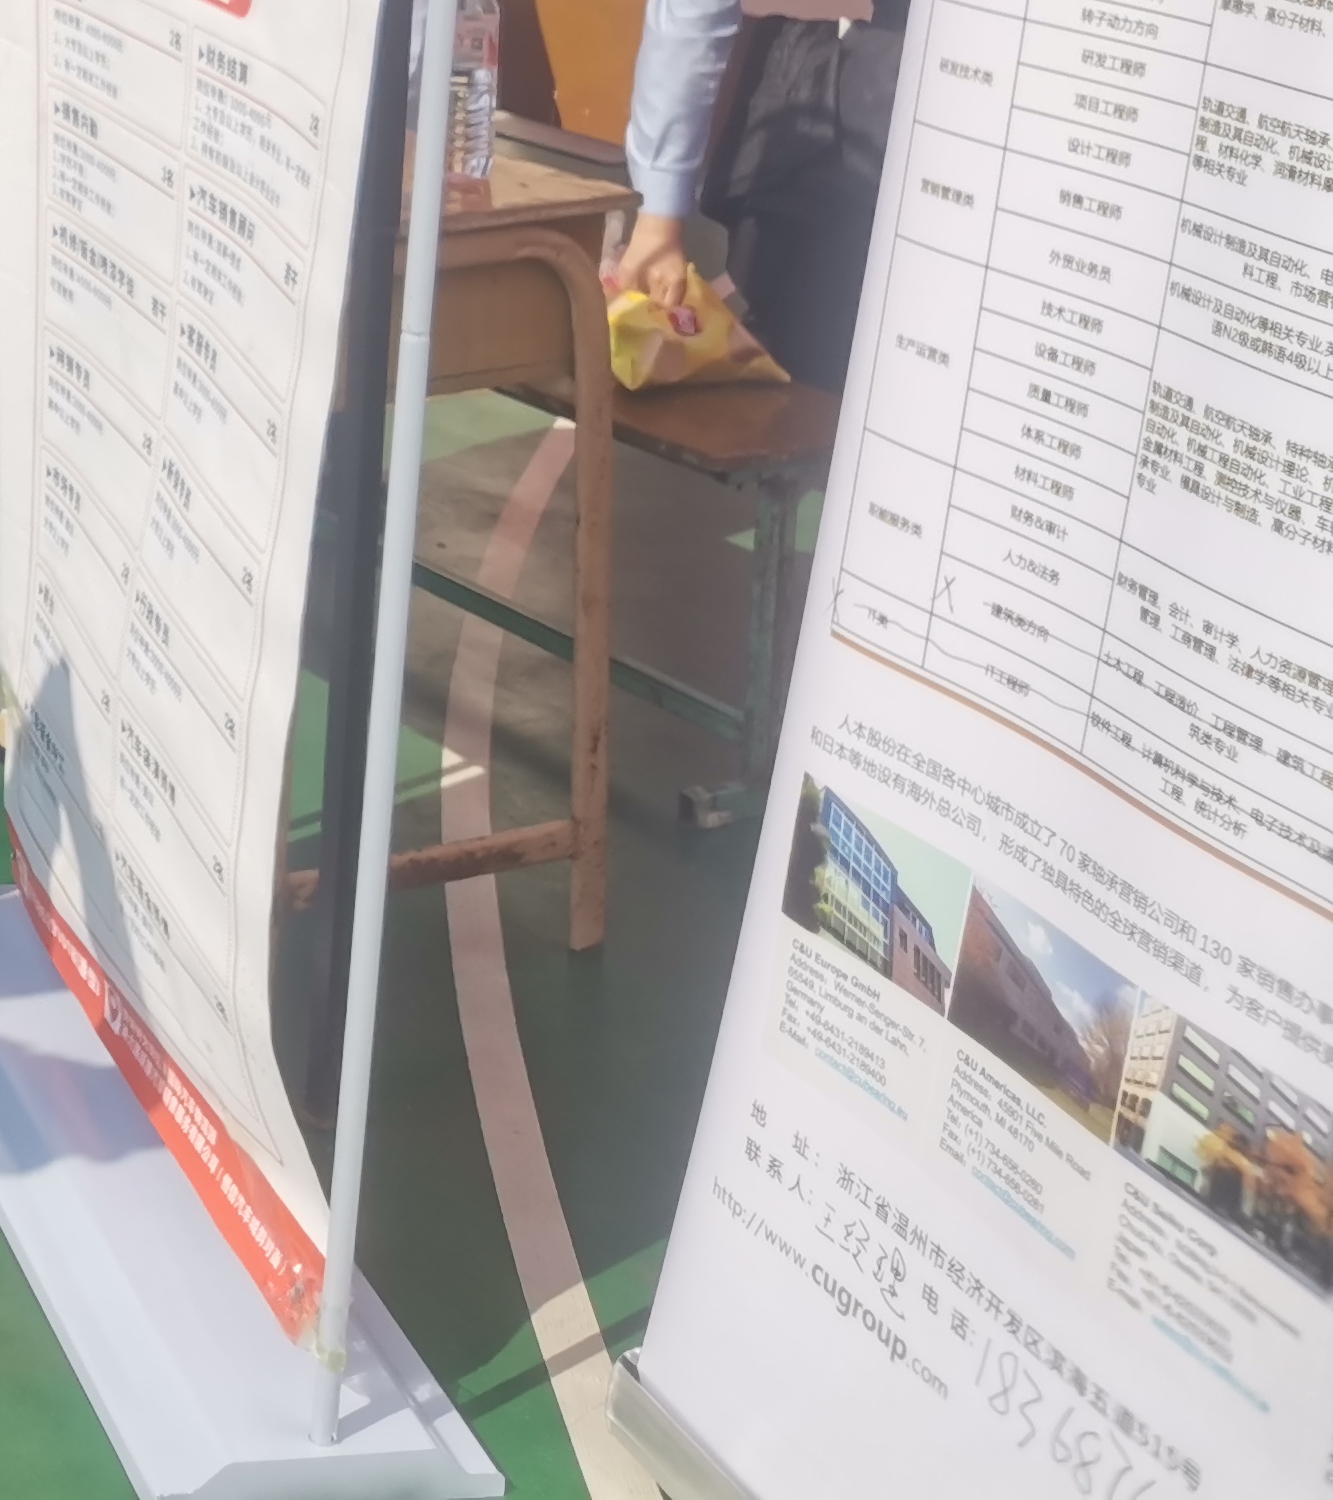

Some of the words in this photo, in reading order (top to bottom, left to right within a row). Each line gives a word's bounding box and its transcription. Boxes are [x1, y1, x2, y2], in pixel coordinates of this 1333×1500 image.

[1066, 135, 1133, 169] 设计工程师
[1241, 262, 1333, 311] 料工程、市场营
